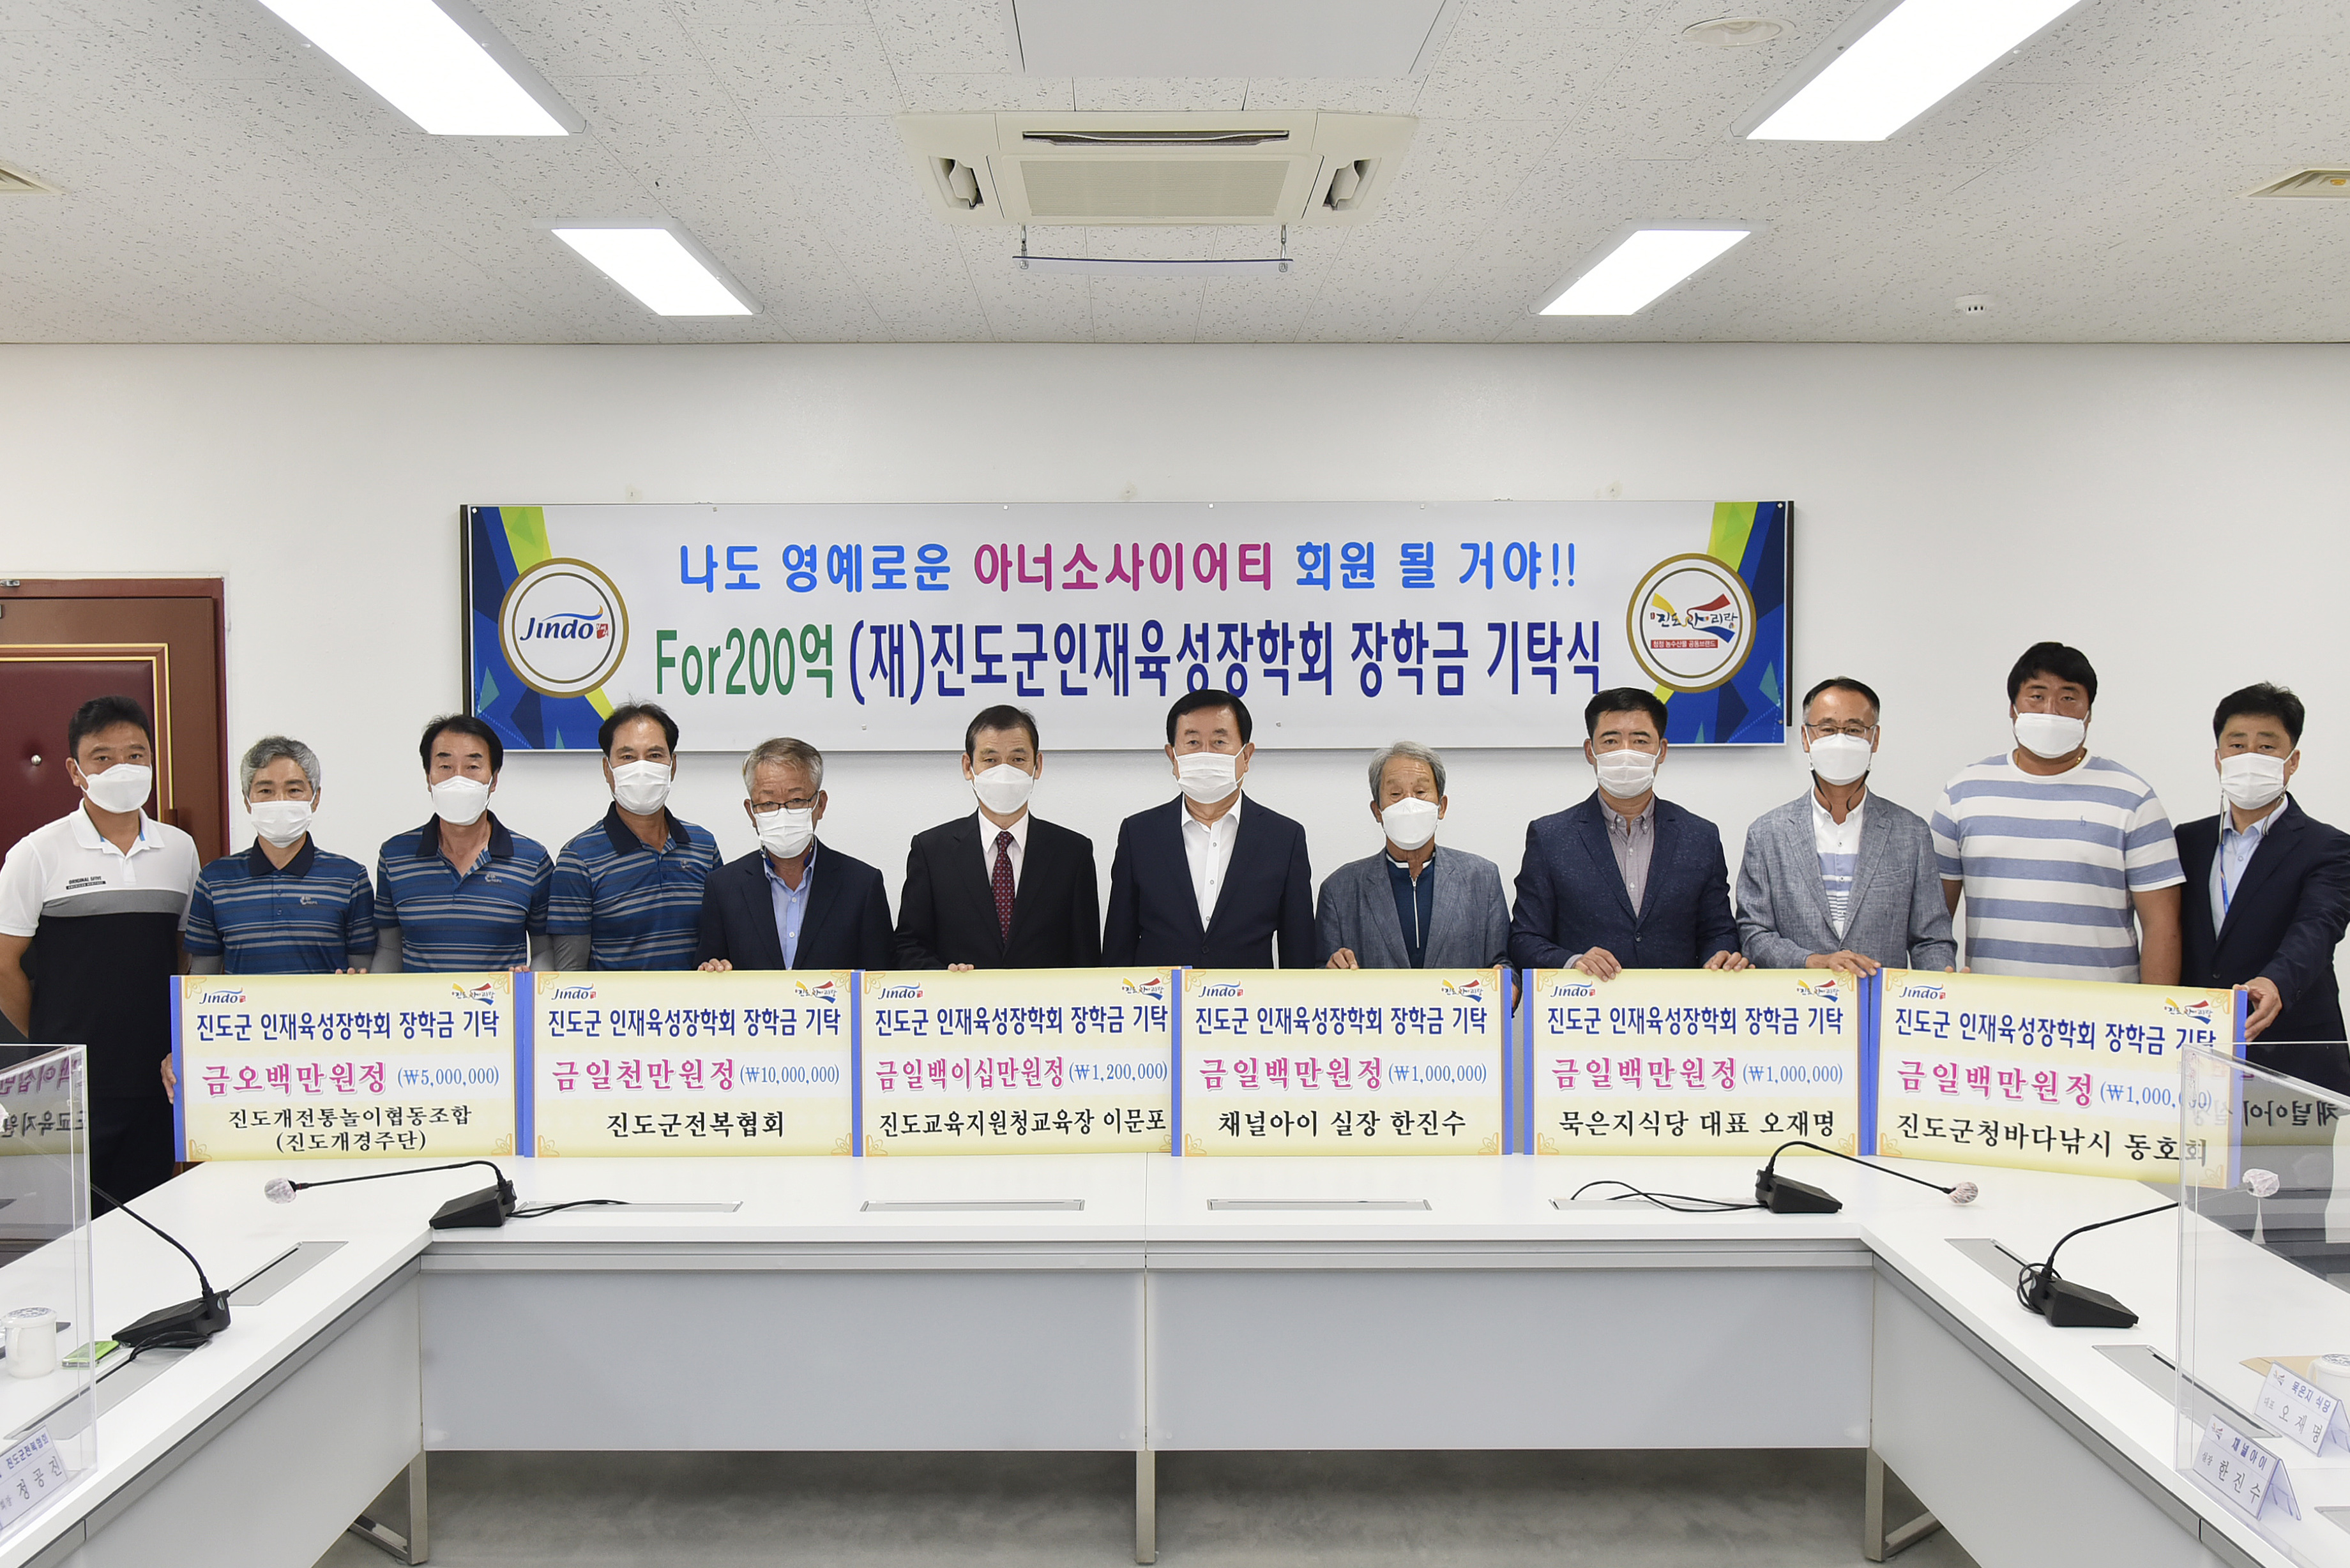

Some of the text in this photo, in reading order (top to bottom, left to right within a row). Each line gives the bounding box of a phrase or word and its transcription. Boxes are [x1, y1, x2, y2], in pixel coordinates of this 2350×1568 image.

[681, 541, 1574, 592] 나도 영예로운 아너소사이어티 회원 될 거야!!
[520, 617, 593, 640] Jindo
[657, 619, 1600, 705] For200억 (재)진도군인재육성장학회 장학금 기탁식
[197, 1011, 499, 1041] 진도군 인재육성장학회 장학금 기탁
[549, 1008, 840, 1037] 진도군 인재육성장학회 장학금 기탁
[876, 1006, 1168, 1036] 진도군 인재육성장학회 장학금 기탁
[1196, 1007, 1487, 1035] 진도군 인재육성장학회 장학금 기탁
[1548, 1007, 1843, 1035] 진도군 인재육성장학회 장학금 기탁
[1896, 1009, 1950, 1038] 진도군
[1960, 1013, 2095, 1050] 인재육성장학회
[2105, 1024, 2165, 1055] 장학금
[202, 1062, 383, 1095] 금오백만원정
[553, 1059, 732, 1091] 금일천만원정
[876, 1057, 1062, 1090] 금일백이십만원정
[1200, 1057, 1379, 1089] 금일백만원정
[1552, 1058, 1734, 1089] 금일백만원정
[1898, 1061, 2090, 1106] 금일백만원정
[229, 1105, 471, 1129] 진도개전통놀이협동조합
[607, 1112, 782, 1137] 진도군전복협회
[880, 1108, 1165, 1136] 진도교육지원청교육장 이문포
[1218, 1110, 1466, 1137] 채널아이 실장 한진수
[1559, 1111, 1833, 1136] 묵은지식당 대표 오재명
[277, 1129, 425, 1152] (진도개경주단)
[1898, 1113, 2109, 1157] 진도군청바다낚시
